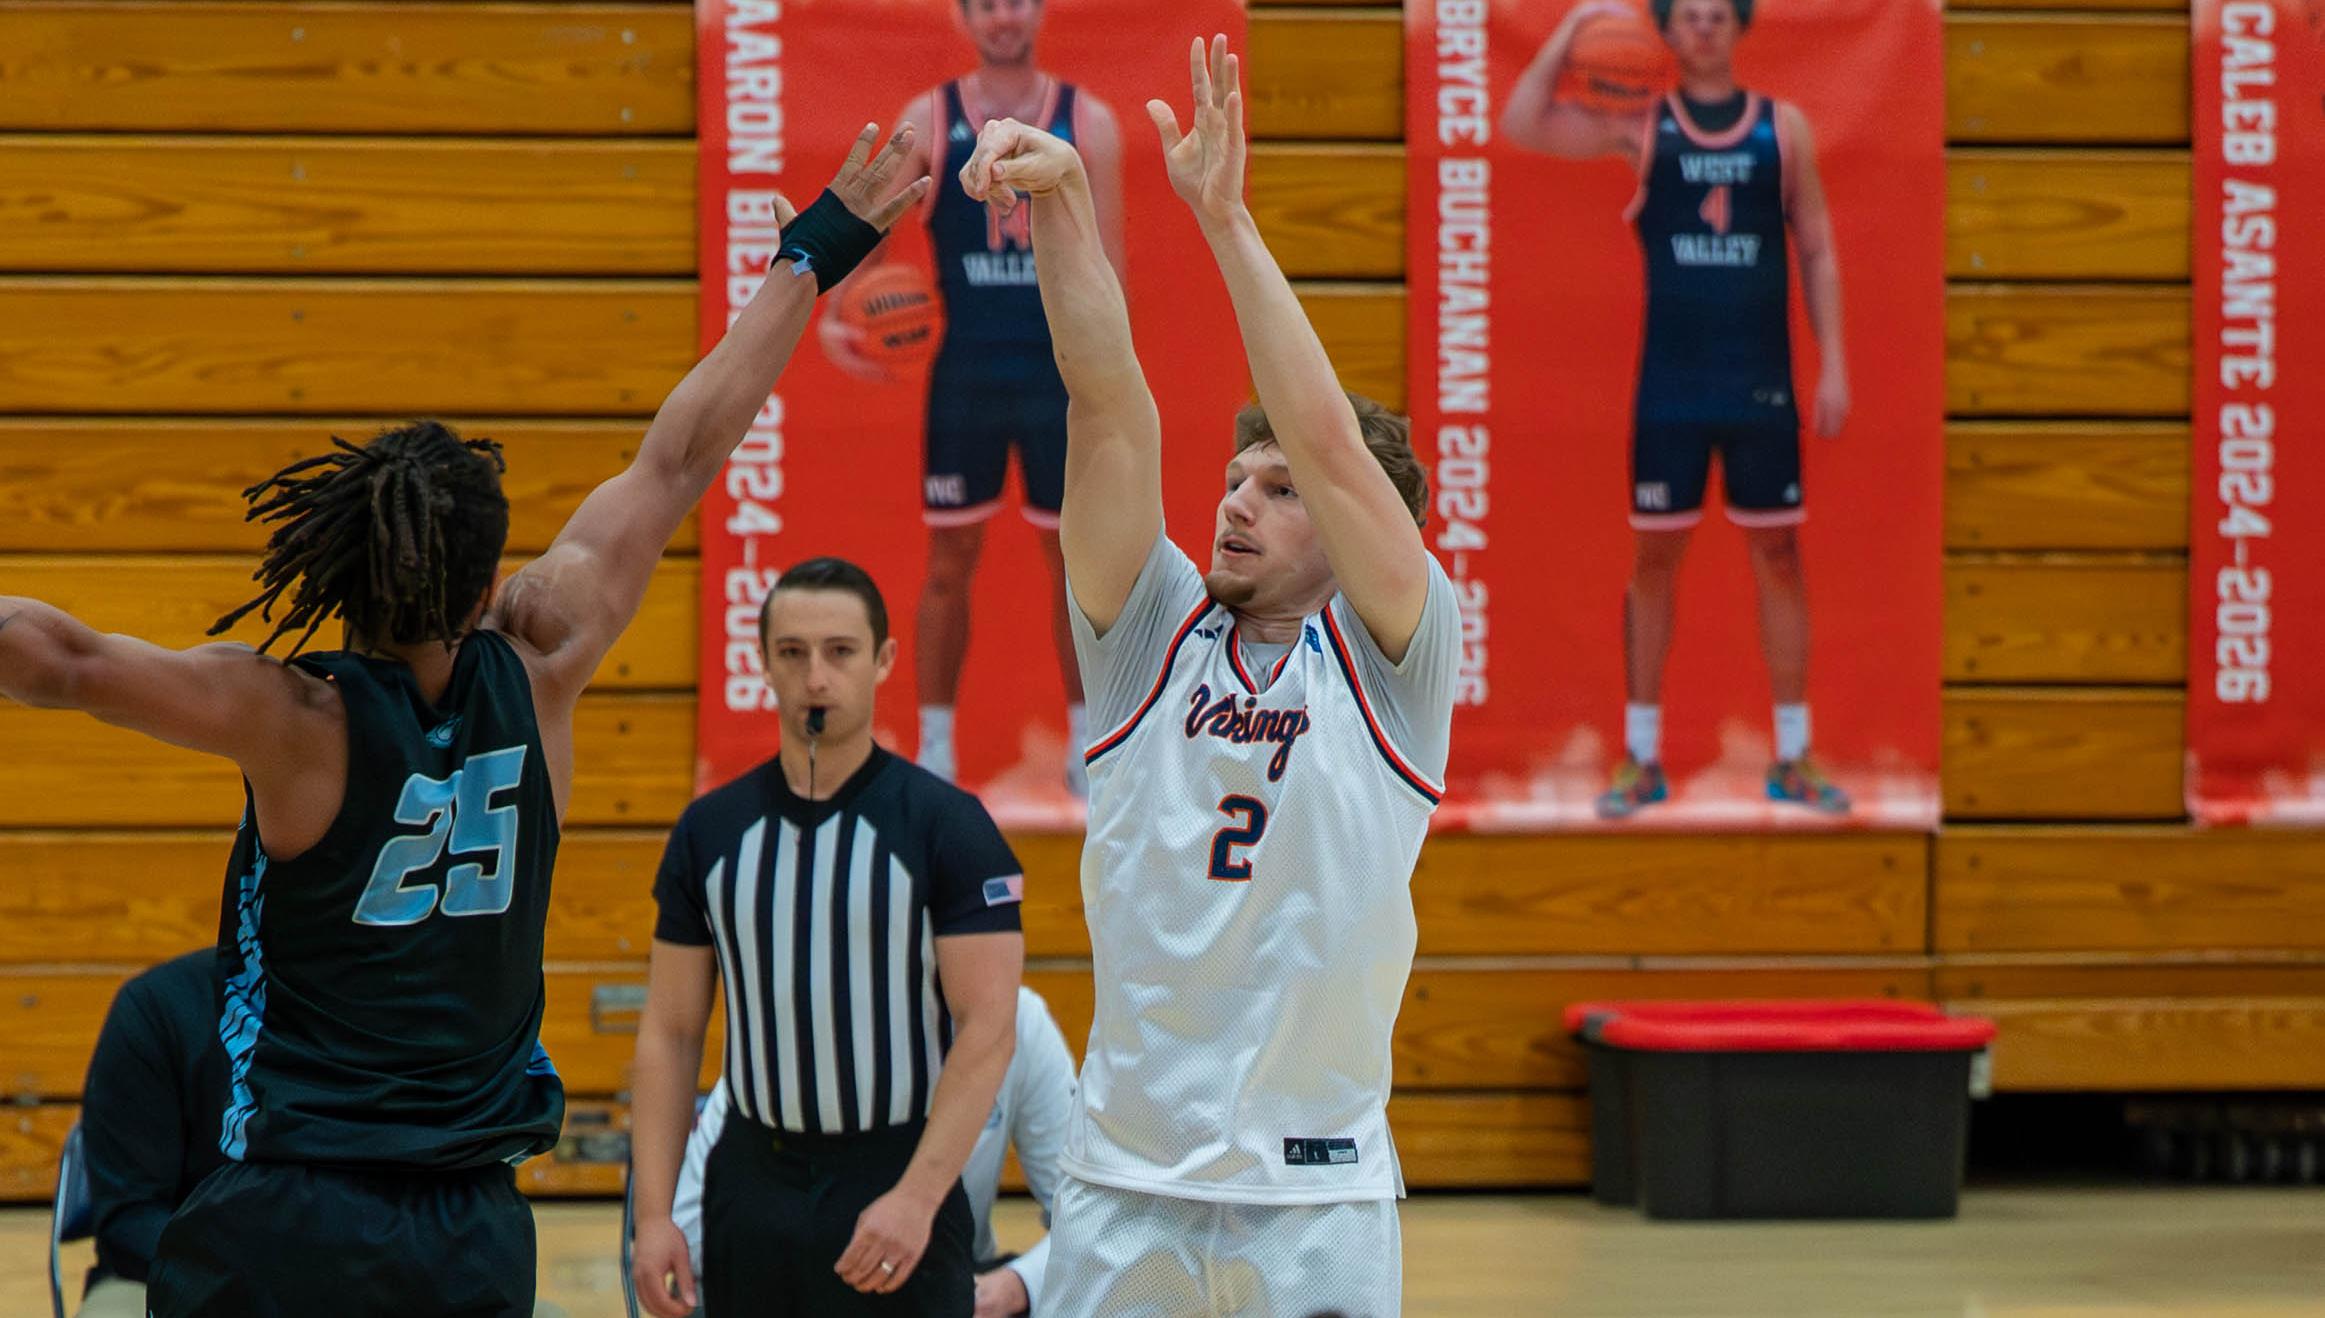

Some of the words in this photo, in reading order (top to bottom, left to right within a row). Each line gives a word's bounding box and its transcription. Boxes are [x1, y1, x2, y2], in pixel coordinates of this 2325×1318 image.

[725, 0, 782, 174] AARON
[1436, 0, 1489, 146] BRYCE
[2220, 3, 2274, 165] CALEB
[1678, 153, 1756, 184] WEST
[1699, 184, 1731, 235] 4
[962, 253, 1037, 287] VALLE
[1438, 157, 1490, 412] BUCHANAN
[1671, 233, 1763, 267] VALLEY
[2221, 179, 2275, 390] ASANTE
[2216, 402, 2273, 703] 2024-2026
[352, 744, 527, 926] 25
[1207, 793, 1268, 882] 2
